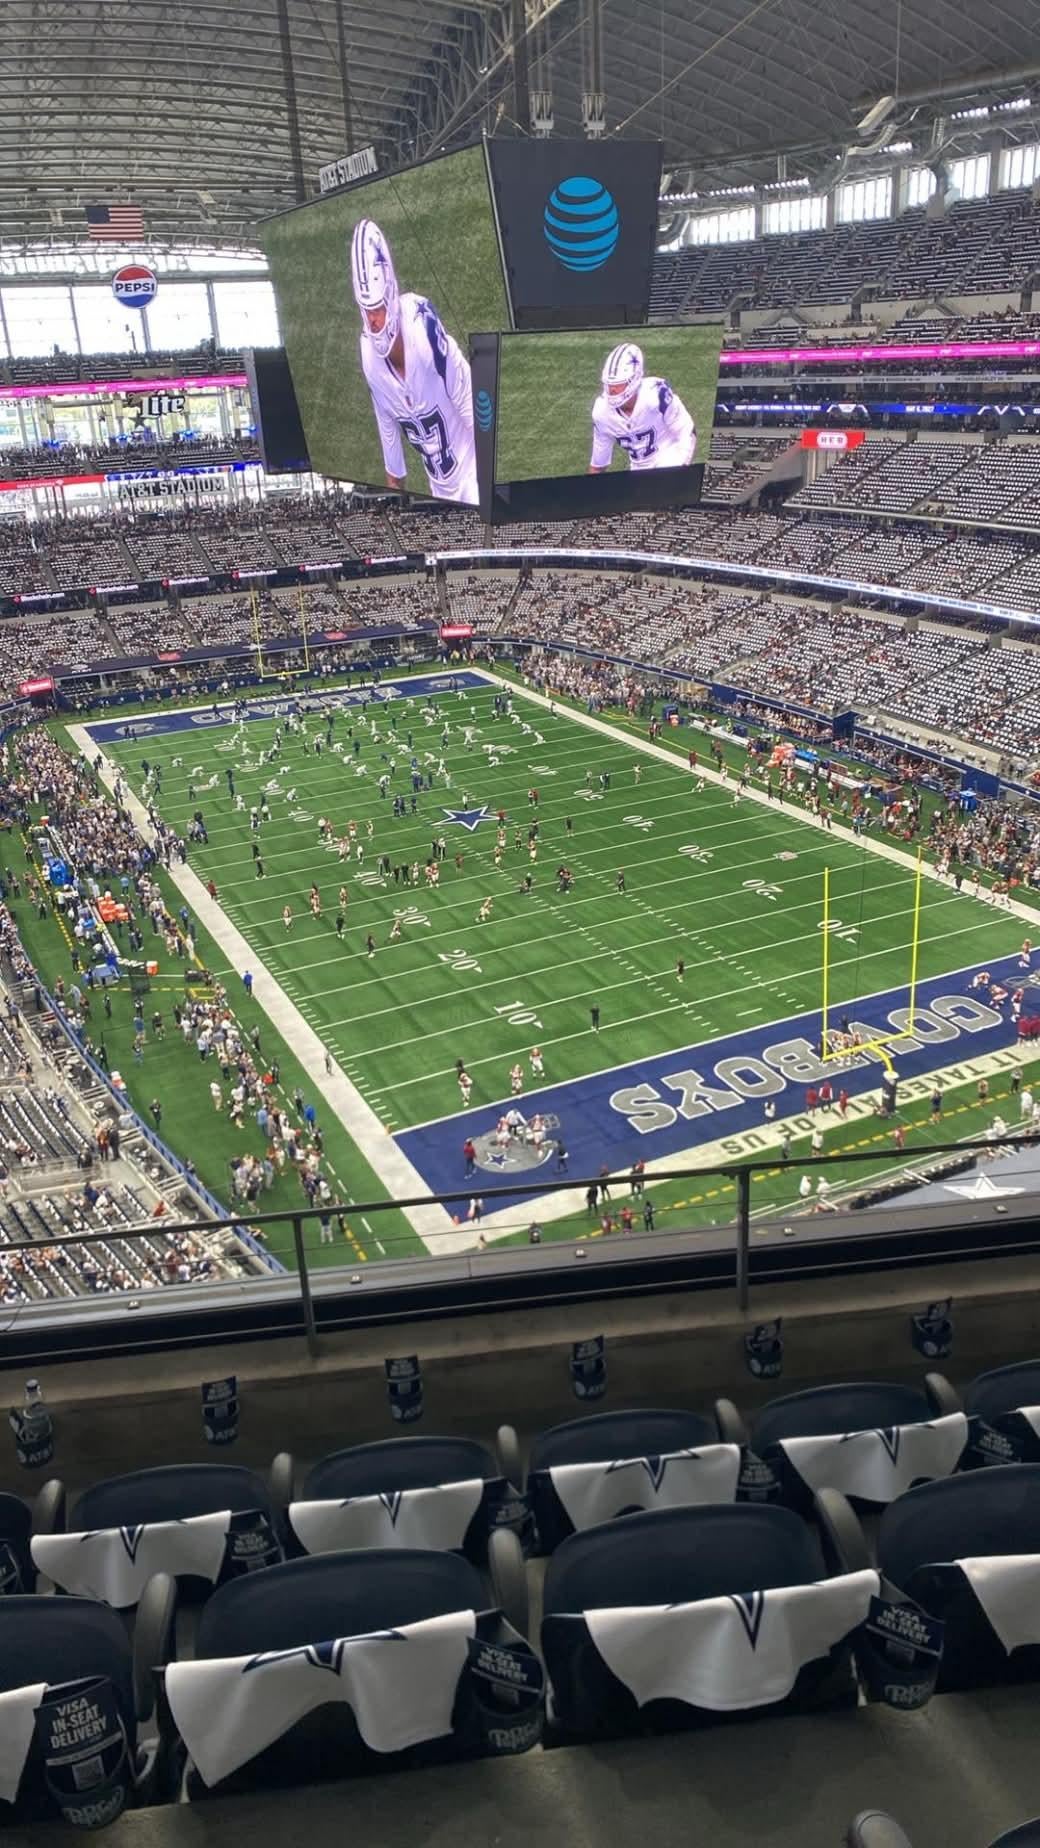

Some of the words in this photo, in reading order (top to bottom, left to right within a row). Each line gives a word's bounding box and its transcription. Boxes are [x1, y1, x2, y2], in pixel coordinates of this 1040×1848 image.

[115, 283, 155, 292] PEPSI
[140, 394, 186, 419] Lite
[119, 482, 155, 499] AT&T
[160, 477, 225, 496] STADIUM
[494, 1000, 537, 1026] 10
[610, 995, 1003, 1134] COWBOYS
[52, 1704, 100, 1733] IN-SEAT
[56, 1697, 90, 1717] VISA
[51, 1716, 107, 1749] DELIVERY
